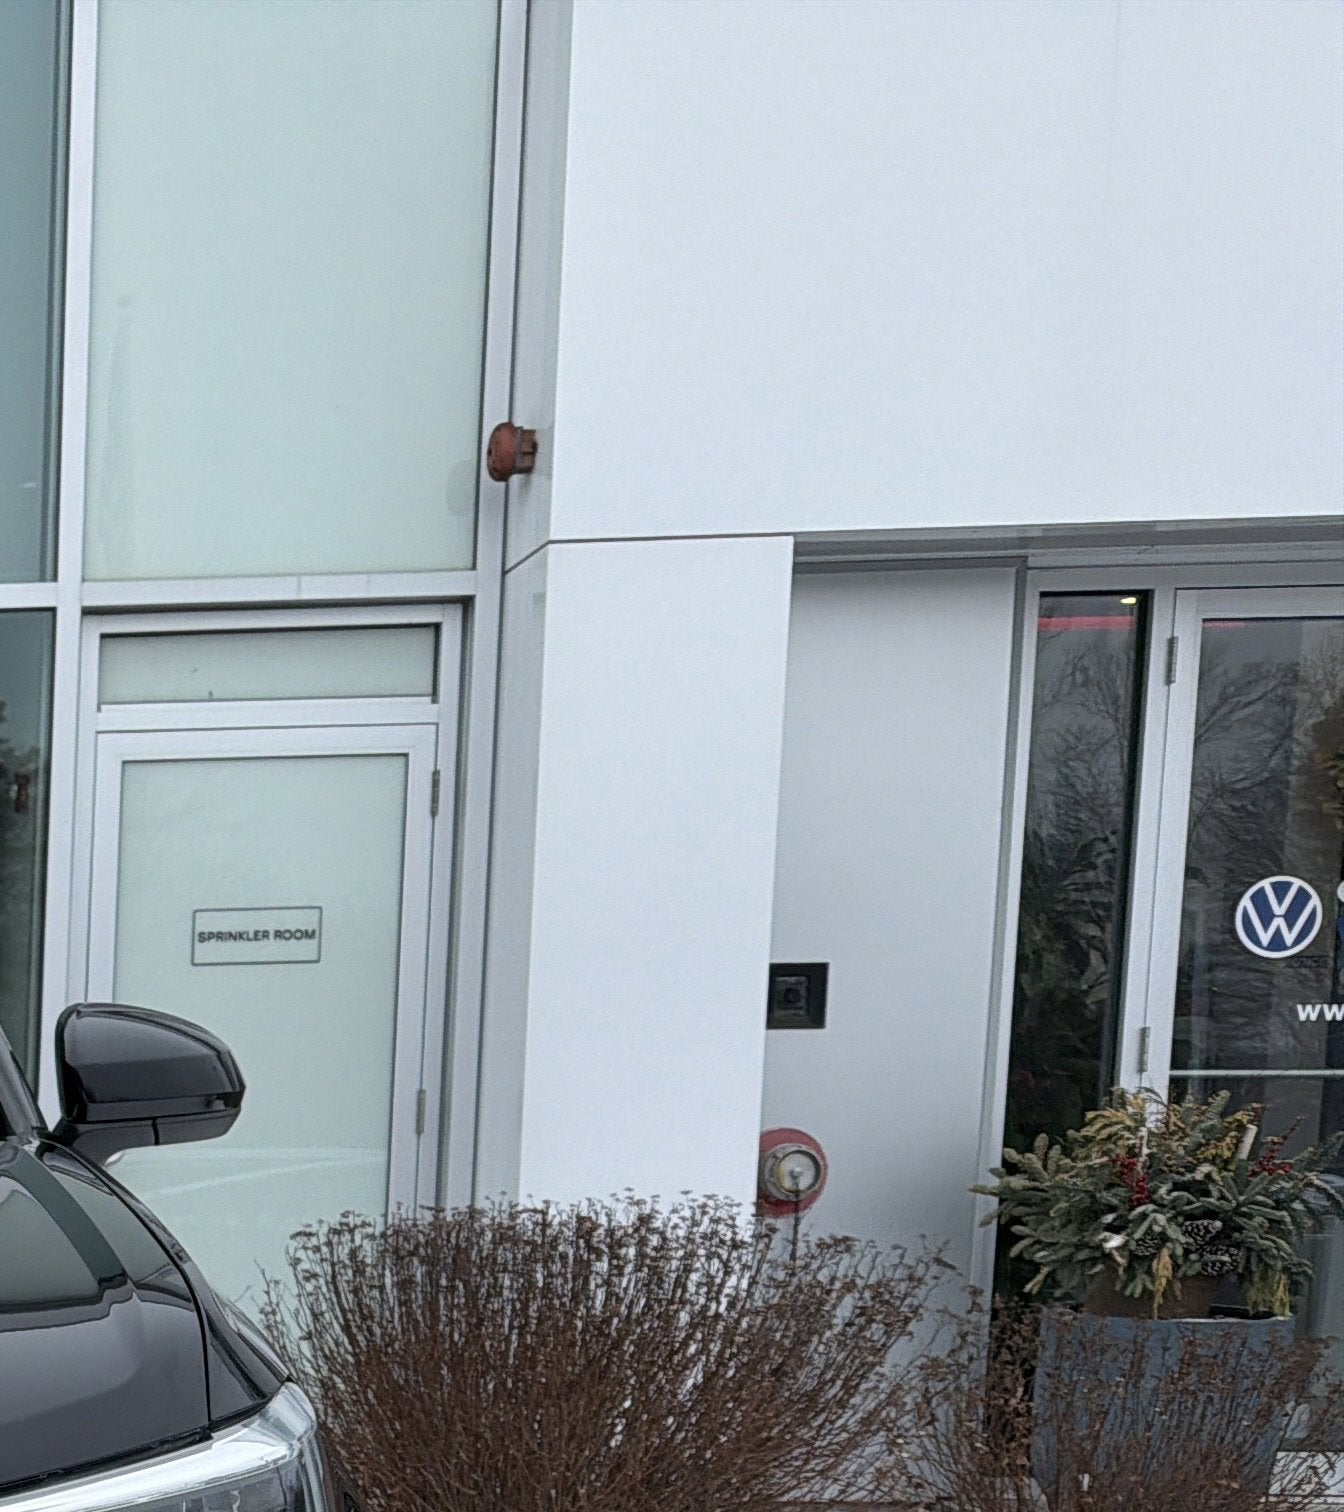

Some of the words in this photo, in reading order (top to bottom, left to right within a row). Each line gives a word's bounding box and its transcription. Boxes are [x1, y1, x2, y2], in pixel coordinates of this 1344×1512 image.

[198, 930, 270, 943] SPRINKLER
[274, 929, 315, 941] ROOM
[1235, 875, 1323, 958] VW
